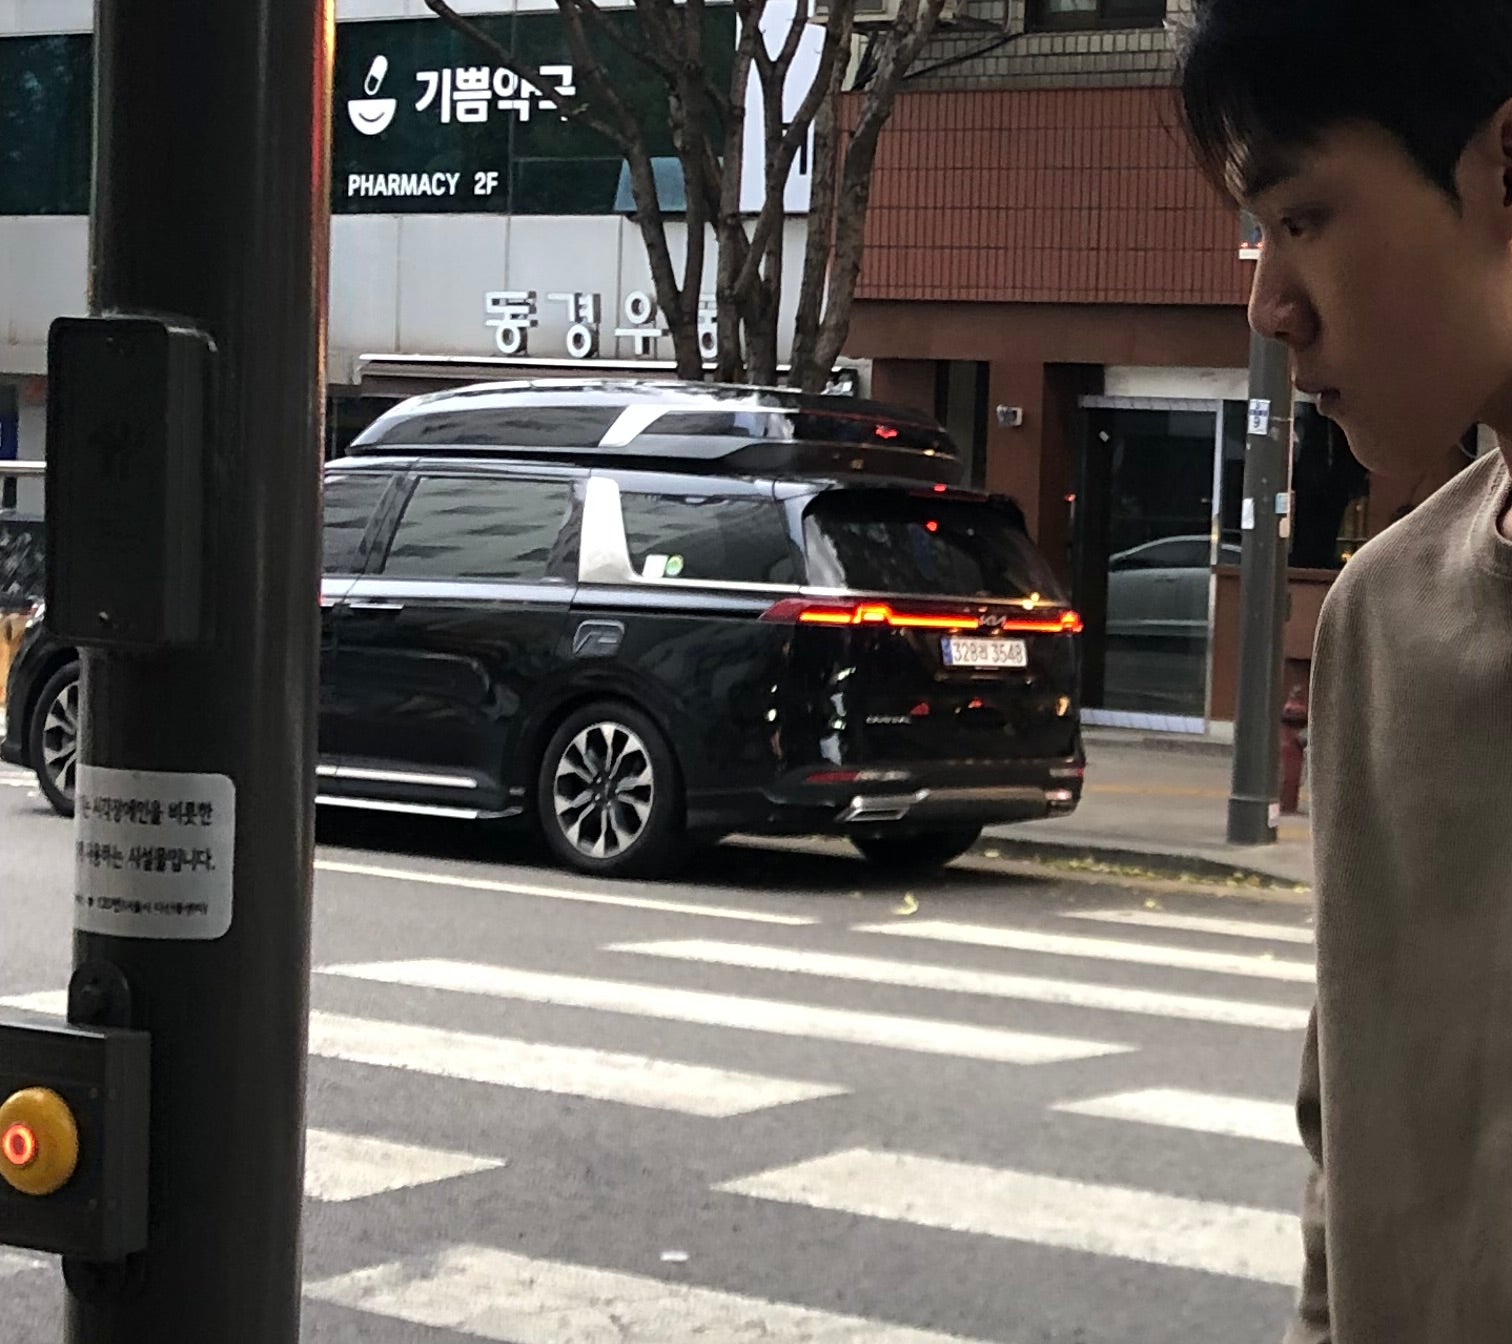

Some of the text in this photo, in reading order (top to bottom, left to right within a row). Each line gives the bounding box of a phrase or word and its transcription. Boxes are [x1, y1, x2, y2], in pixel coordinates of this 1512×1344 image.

[414, 64, 577, 124] 기쁨약국
[348, 171, 499, 198] PHARMACY 2F
